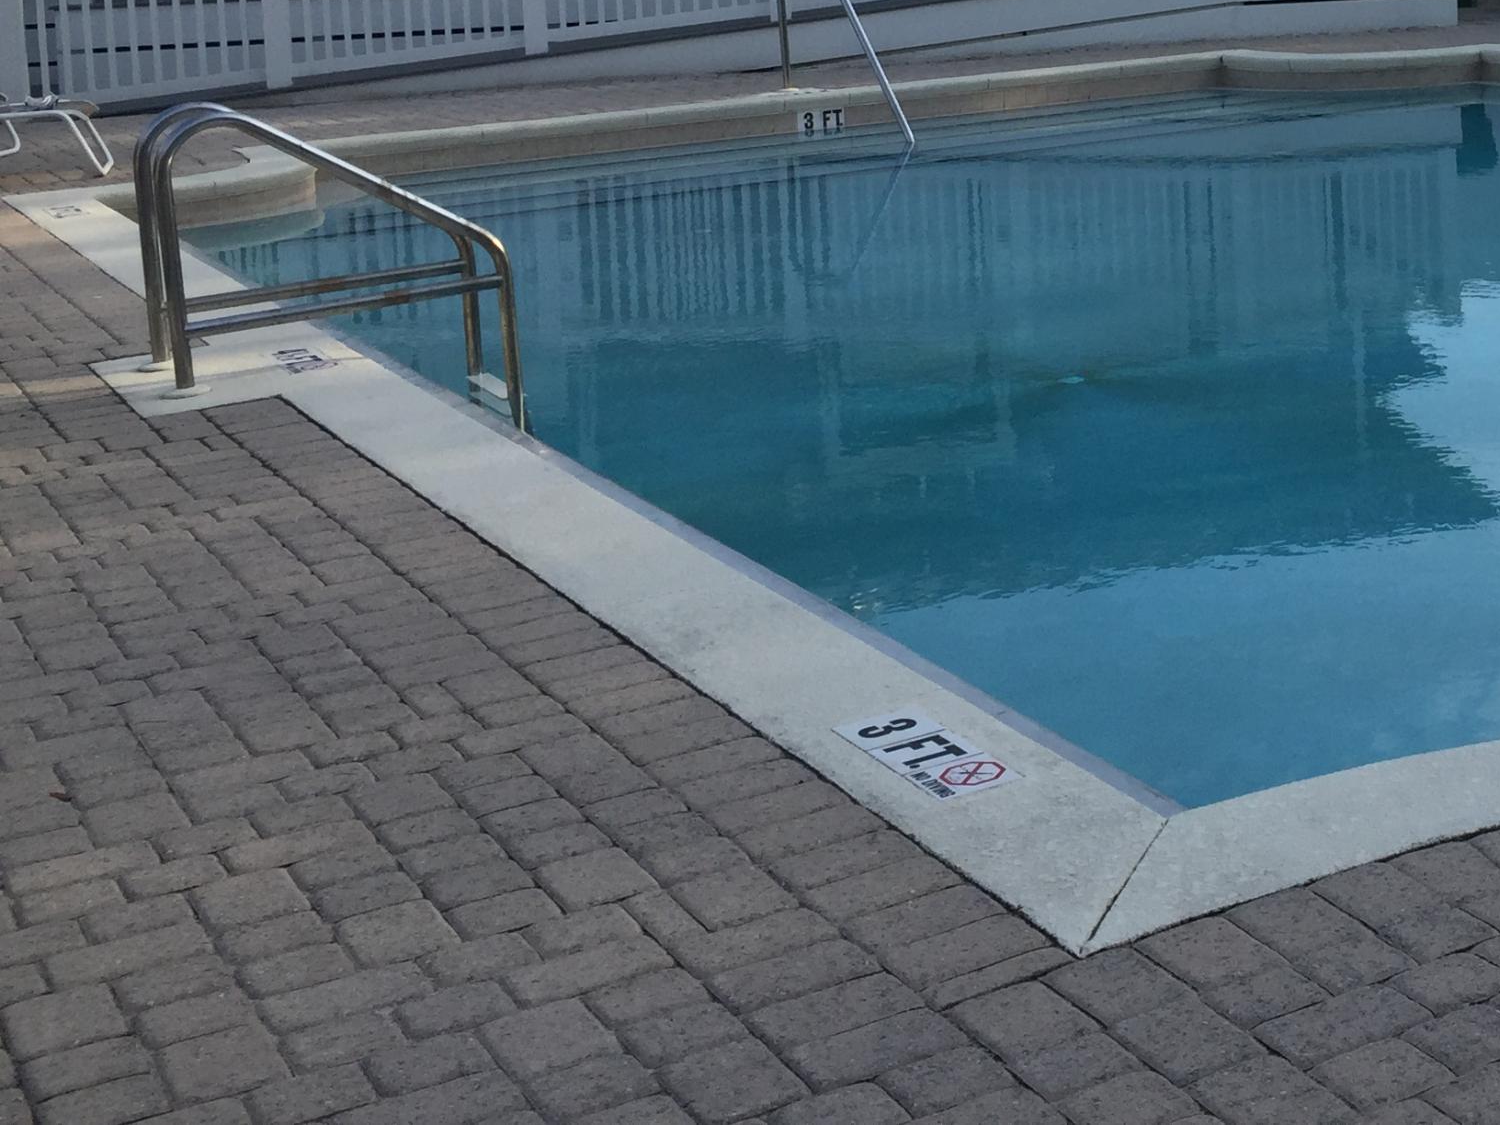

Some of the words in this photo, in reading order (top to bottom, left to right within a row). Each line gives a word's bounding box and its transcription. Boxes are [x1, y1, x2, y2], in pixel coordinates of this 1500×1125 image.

[803, 112, 814, 129] 3
[822, 109, 843, 127] FT.
[858, 717, 917, 739] 3
[883, 734, 968, 769] FT.
[911, 770, 931, 781] NO
[921, 778, 956, 798] DIVING
